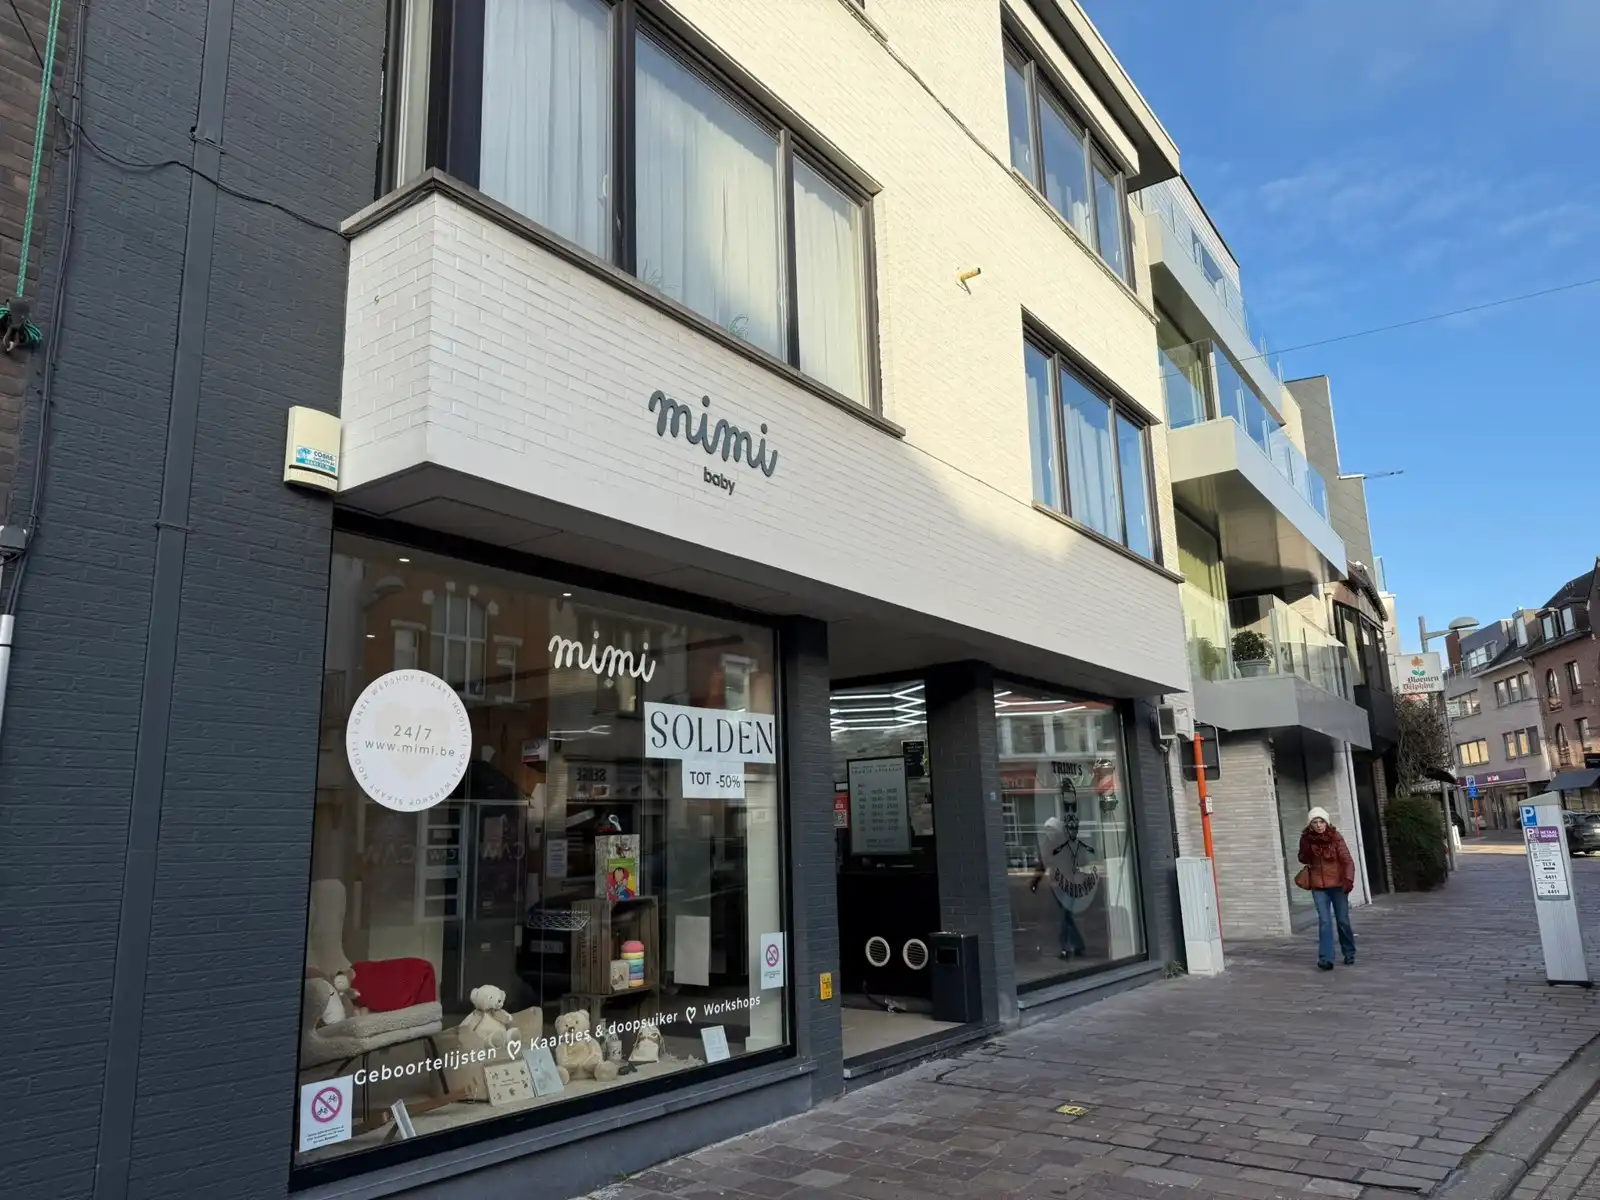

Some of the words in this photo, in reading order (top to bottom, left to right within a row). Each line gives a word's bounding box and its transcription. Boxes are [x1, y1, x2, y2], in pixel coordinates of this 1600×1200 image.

[648, 390, 778, 478] mimi
[703, 466, 736, 496] baby
[548, 630, 656, 683] mimi
[364, 740, 455, 758] www.mimi.be
[393, 724, 432, 742] 24/7
[650, 711, 773, 754] SOLDEN
[689, 771, 711, 786] TOT
[716, 774, 741, 788] -50%
[354, 1047, 496, 1085] Geboortelijsten
[530, 1028, 591, 1051] Kaartjes
[595, 1025, 604, 1037] &
[608, 1010, 678, 1035] doopsuiker
[704, 995, 761, 1017] Workshops
